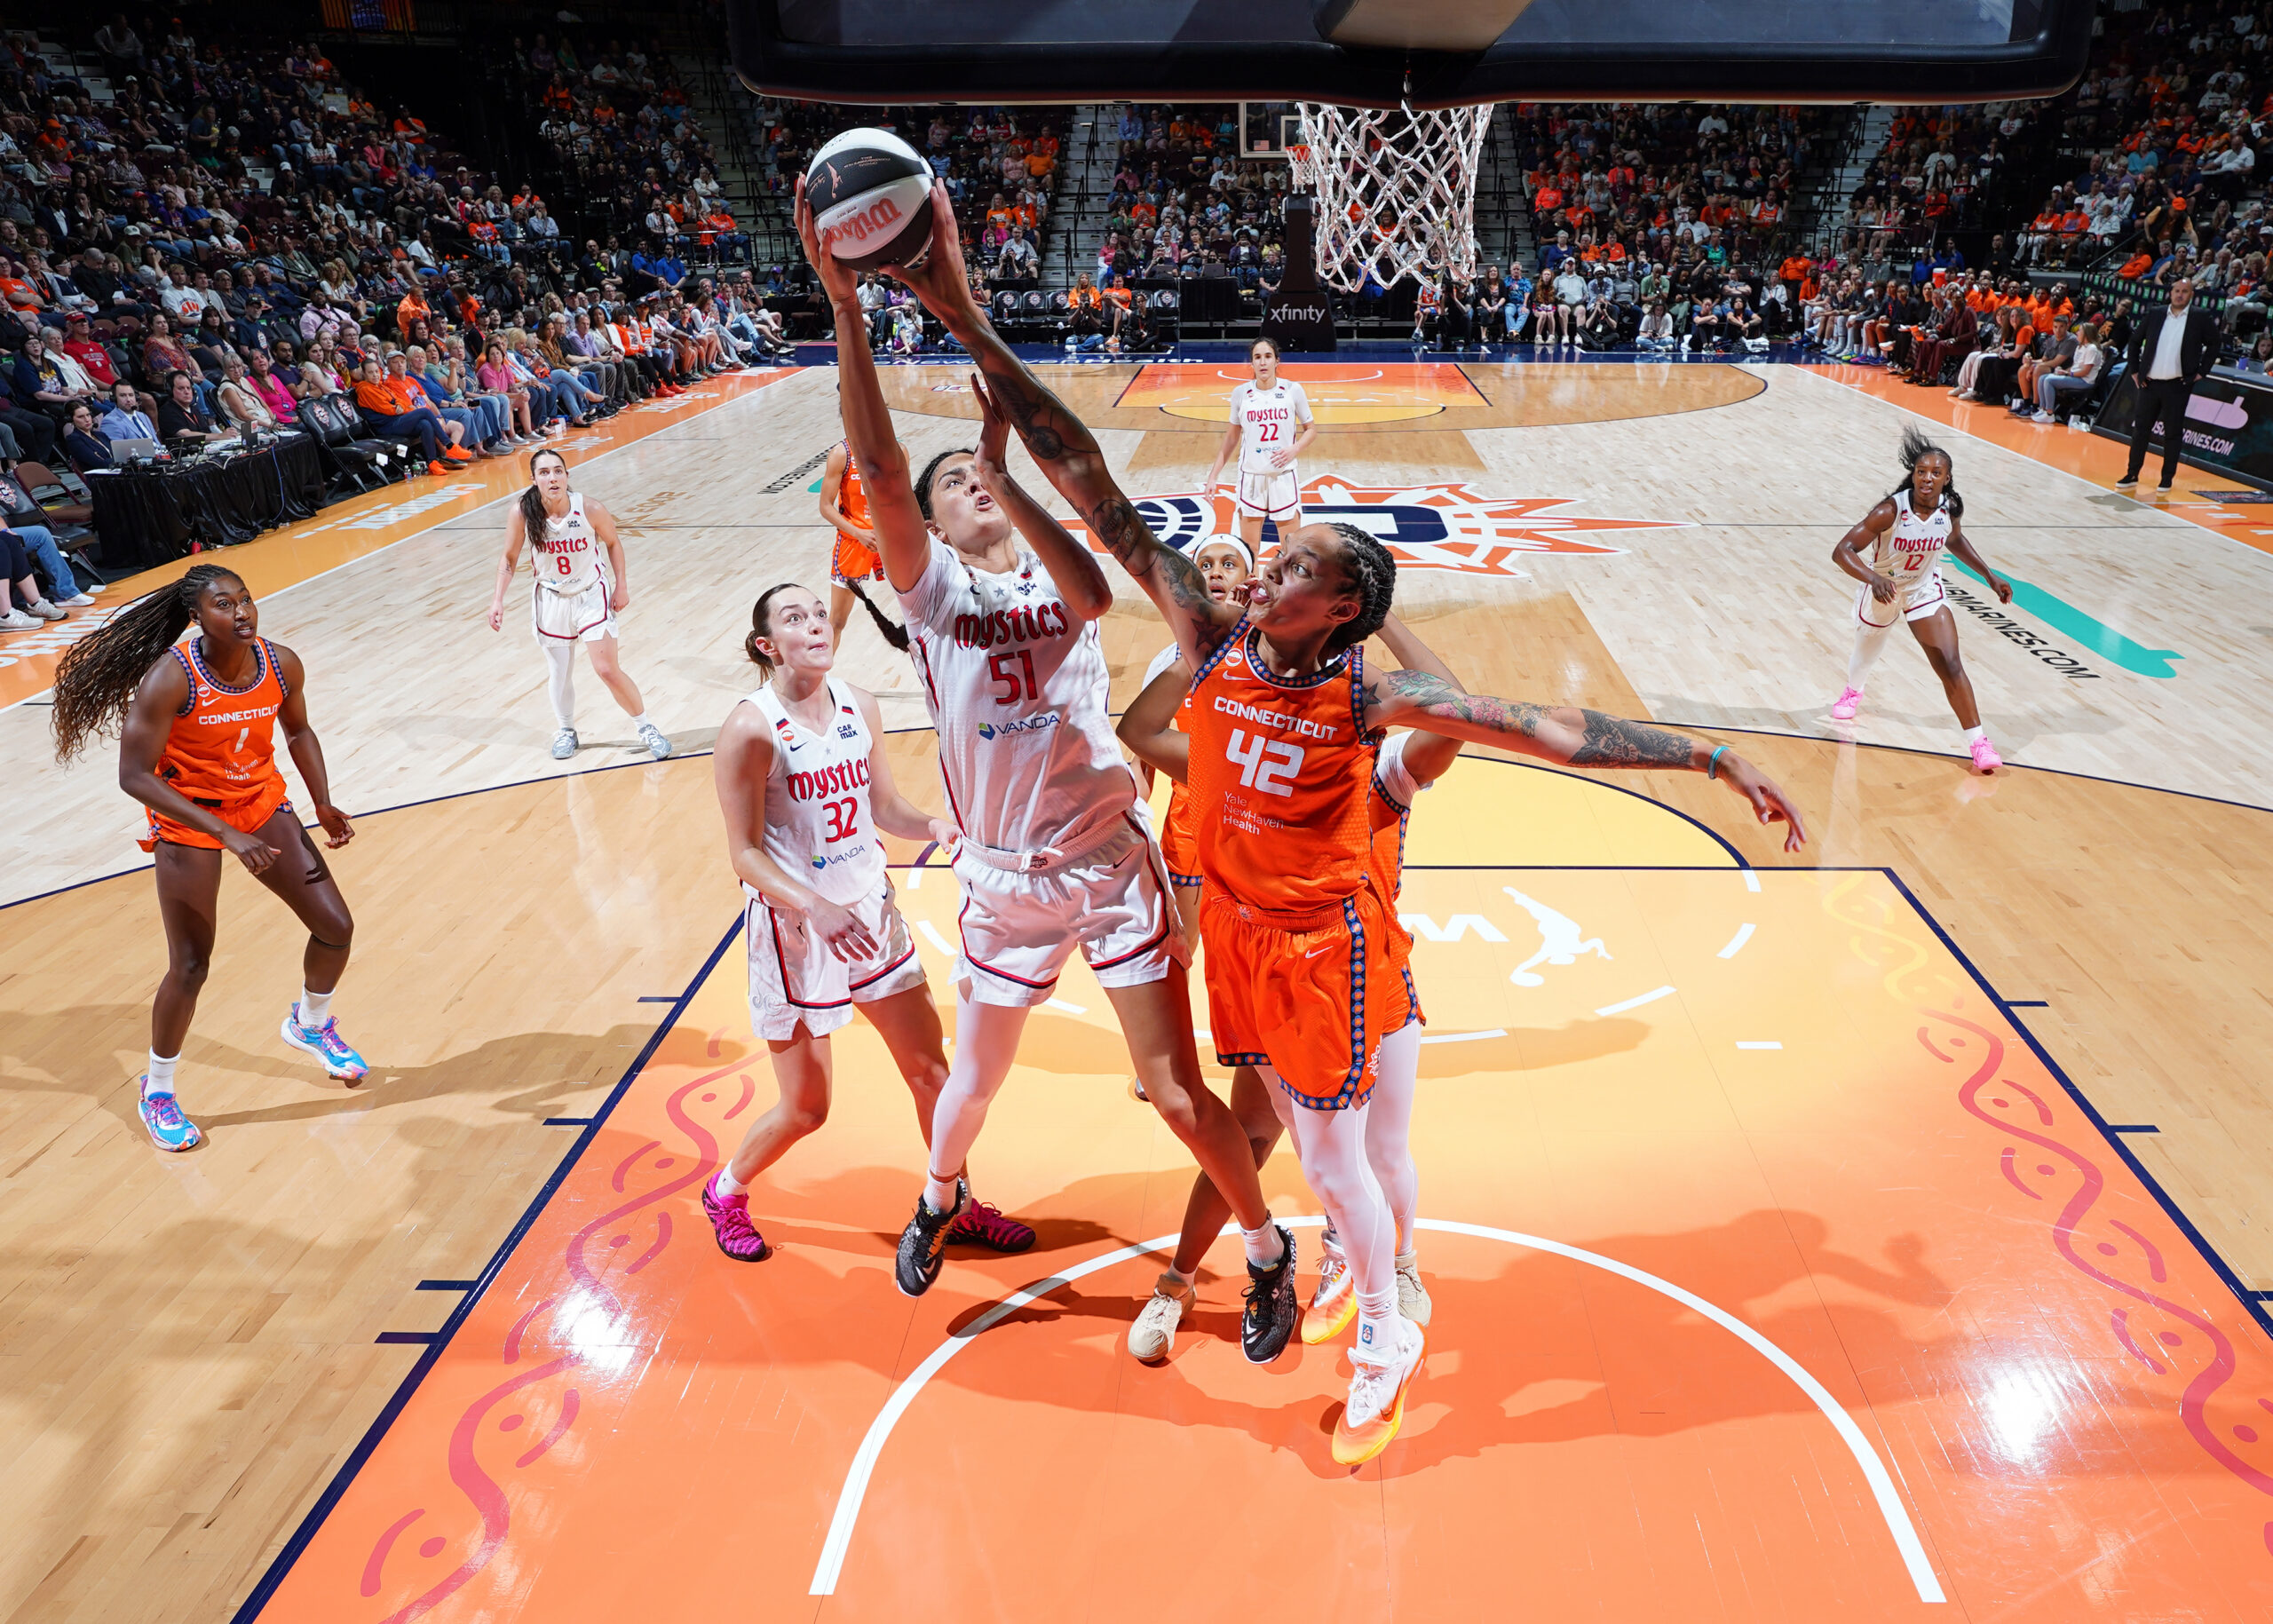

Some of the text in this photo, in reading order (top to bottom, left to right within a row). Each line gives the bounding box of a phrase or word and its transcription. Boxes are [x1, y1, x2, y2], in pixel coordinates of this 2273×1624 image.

[820, 198, 903, 242] Wilso
[1270, 304, 1326, 323] xfinity
[1247, 408, 1288, 423] mystics
[1258, 424, 1279, 442] 22
[1894, 536, 1944, 552] mystics
[557, 556, 571, 574] 8
[1904, 554, 1924, 571] 12
[955, 602, 1068, 651] mystics
[988, 649, 1038, 705] 51
[198, 703, 280, 725] CONNECTICUT
[996, 715, 1061, 734] VANDA
[1214, 695, 1338, 741] CONNECTICUT
[837, 724, 852, 733] CAR
[840, 729, 859, 740] max
[234, 727, 249, 753] 1
[1226, 728, 1305, 797] 42
[1224, 791, 1247, 807] Yale
[822, 796, 858, 844] 32
[1223, 815, 1260, 836] Health
[1224, 804, 1284, 829] NewHaven
[827, 844, 866, 865] VANDA
